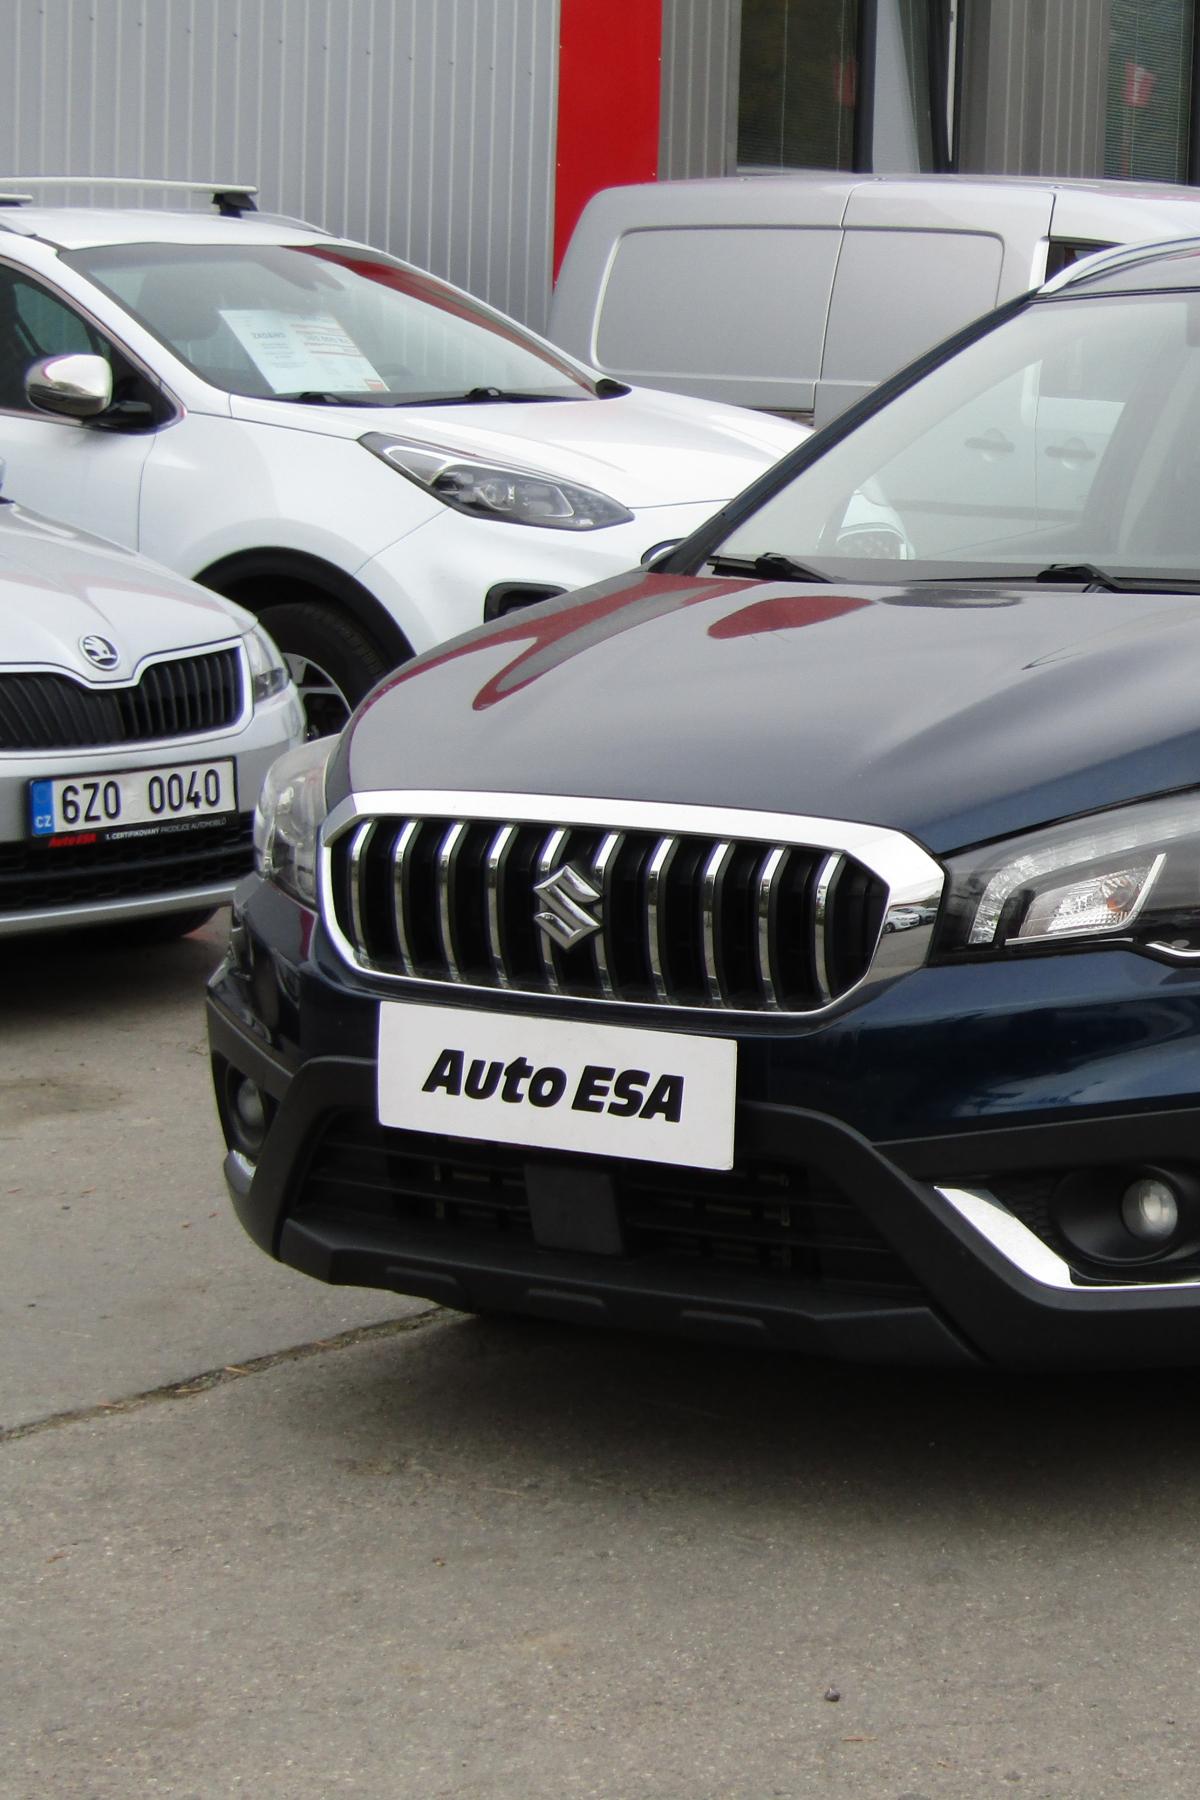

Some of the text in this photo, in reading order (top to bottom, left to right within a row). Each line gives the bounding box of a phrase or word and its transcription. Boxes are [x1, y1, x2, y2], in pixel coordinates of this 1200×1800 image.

[34, 814, 52, 828] CZ
[62, 768, 221, 824] 6Z0 0040
[421, 1048, 684, 1123] Auto ESA
